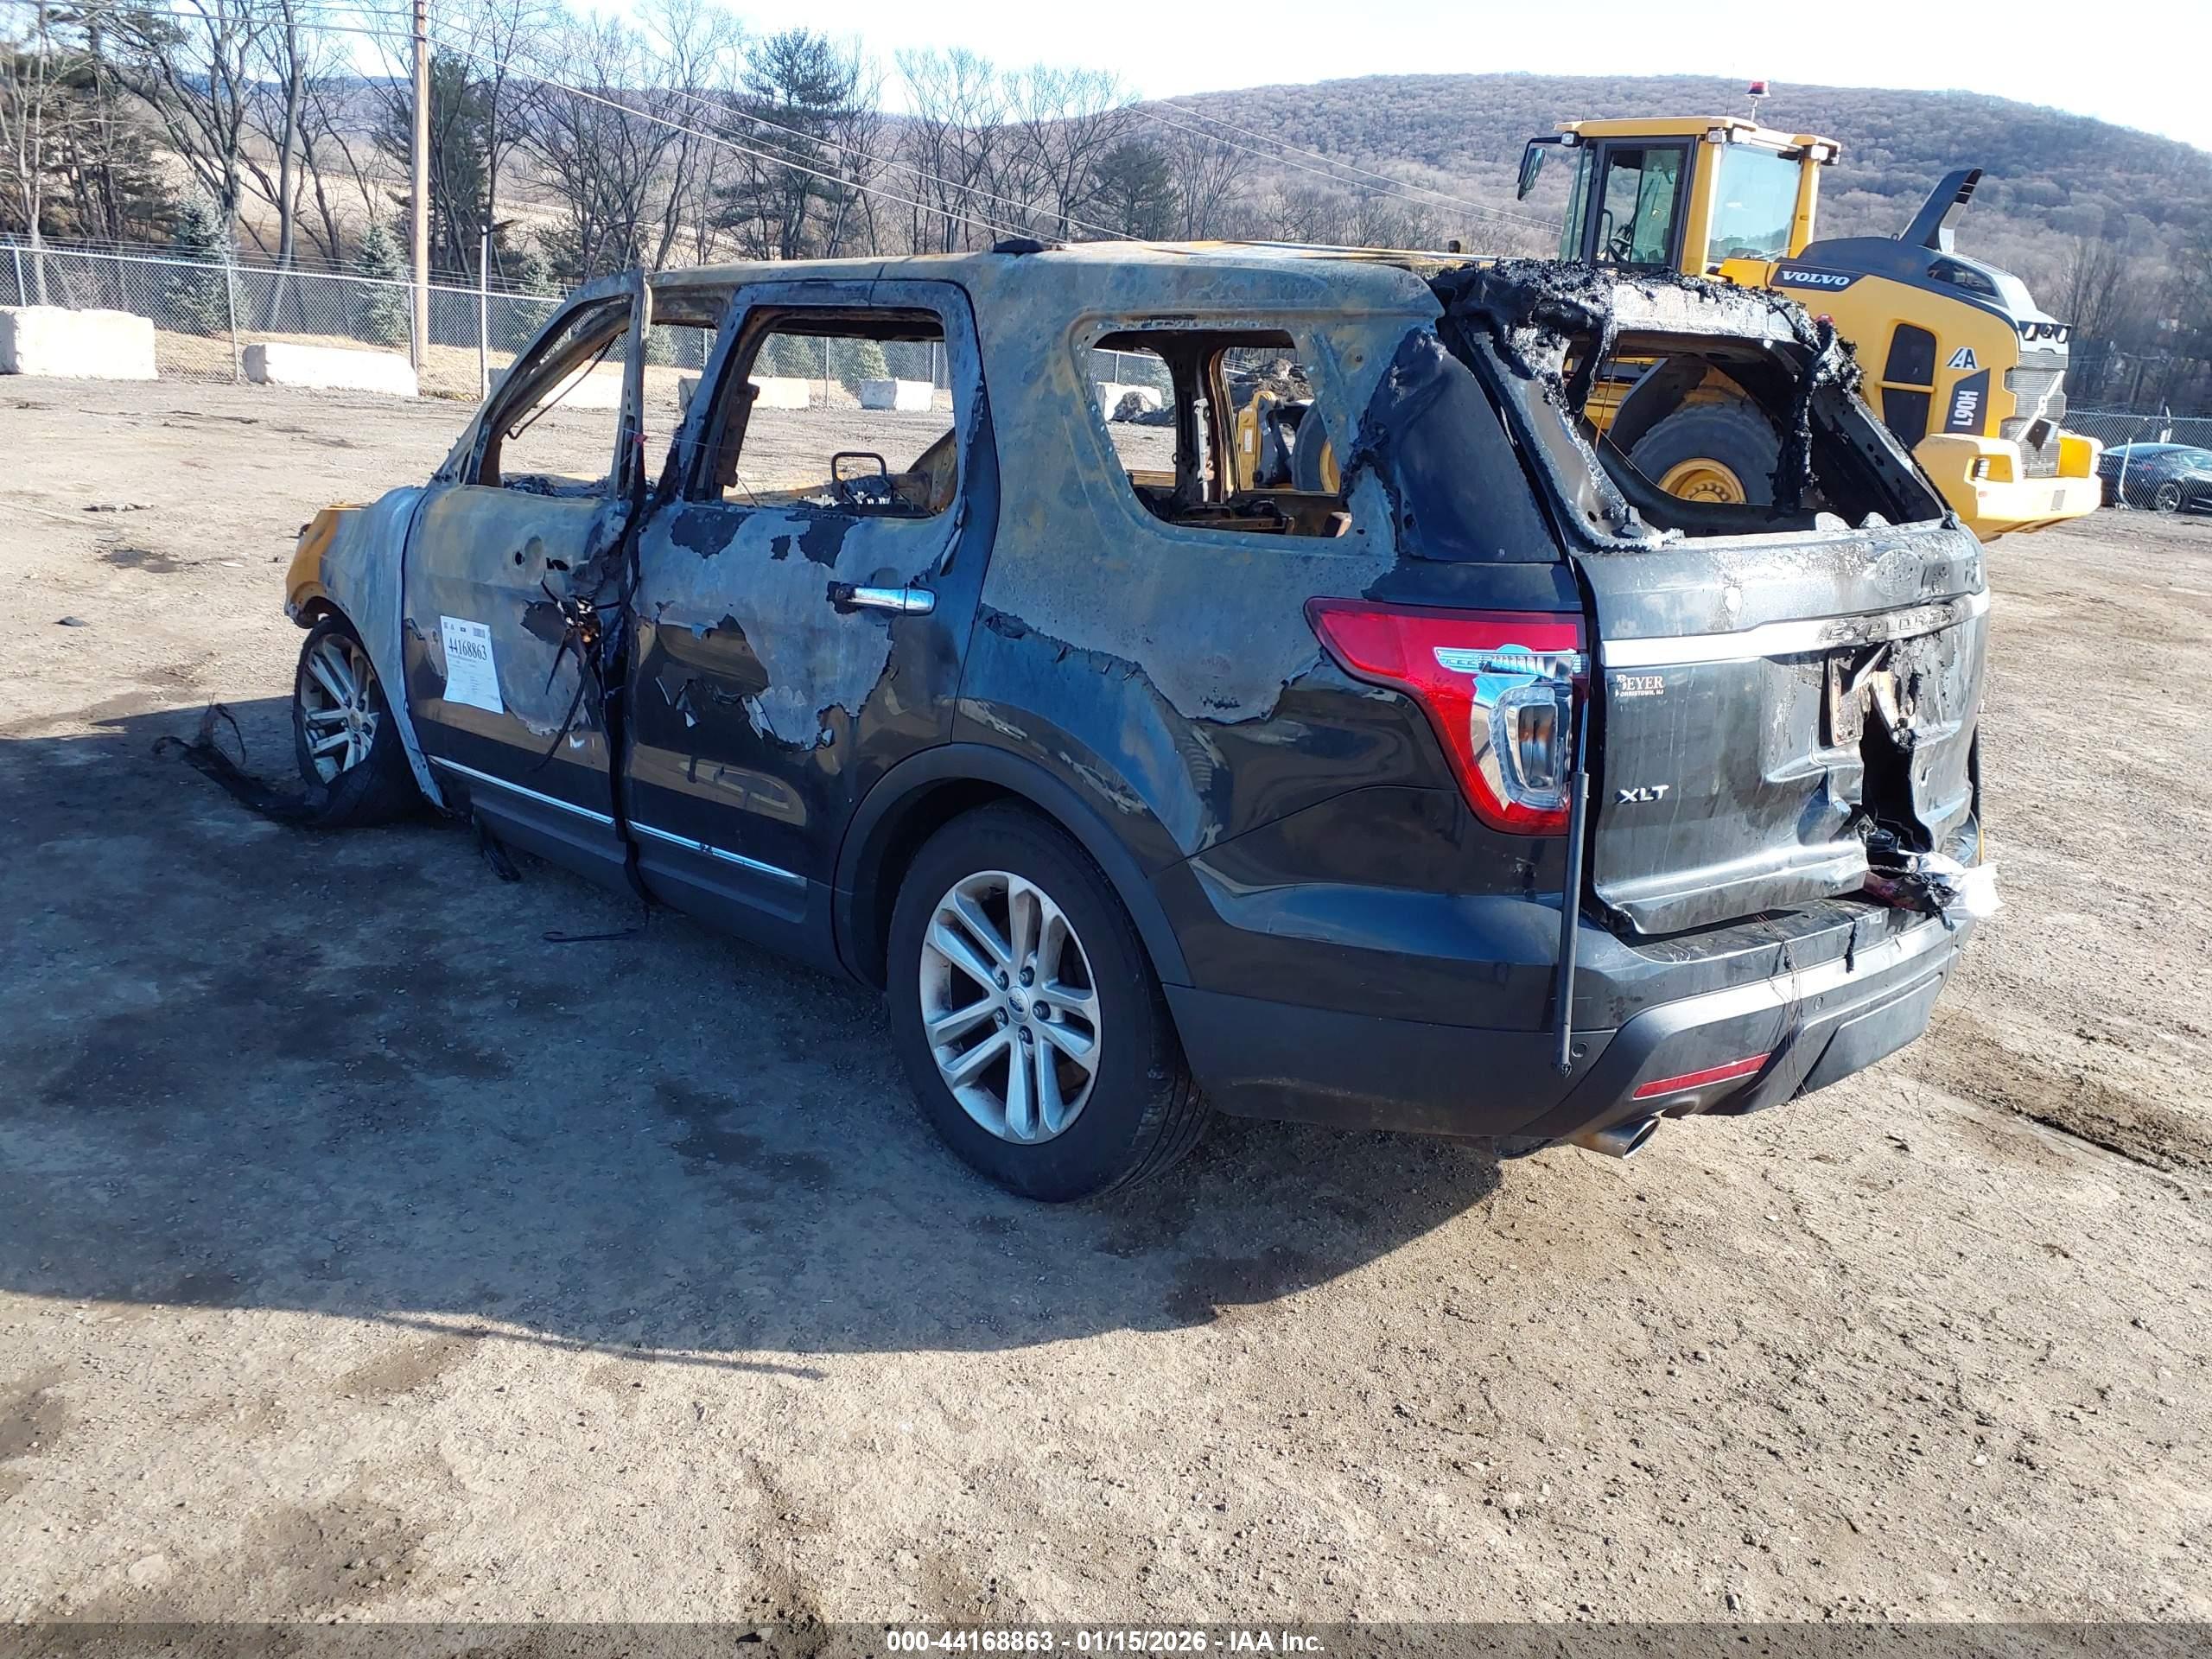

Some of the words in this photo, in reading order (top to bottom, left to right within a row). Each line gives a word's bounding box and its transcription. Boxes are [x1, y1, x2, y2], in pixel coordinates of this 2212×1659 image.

[1782, 270, 1850, 286] VOLVO
[1953, 391, 1979, 426] L90H
[448, 637, 487, 660] 44168863
[1616, 674, 1664, 690] BEYER
[1619, 785, 1669, 804] XLT
